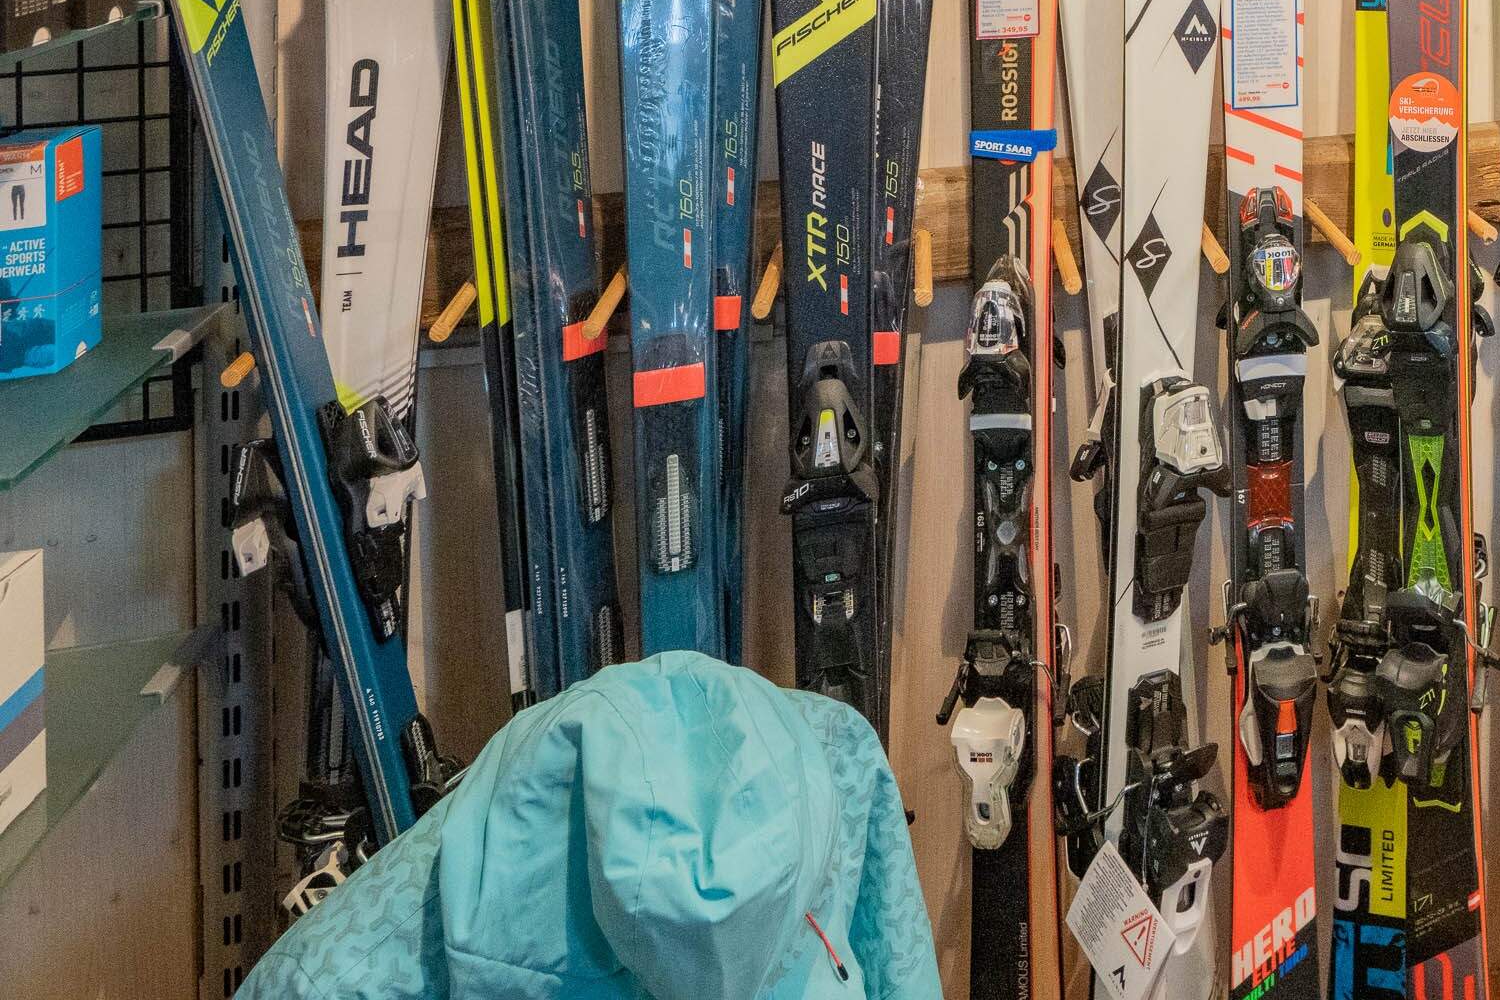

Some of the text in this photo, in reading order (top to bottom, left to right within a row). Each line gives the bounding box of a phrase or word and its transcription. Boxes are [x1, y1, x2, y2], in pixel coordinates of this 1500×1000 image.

[1001, 42, 1019, 121] ROSSIG
[1399, 97, 1415, 106] SKI-
[1399, 105, 1454, 117] VERSICHERUNG
[1401, 126, 1438, 135] JETZT HIER
[336, 58, 379, 258] HEAD
[725, 119, 739, 159] 165
[974, 140, 1033, 155] SPORT SAAR
[1401, 134, 1450, 144] ABSCHLIESSEN
[31, 164, 42, 175] M
[573, 151, 583, 192] 165
[885, 158, 899, 199] 155
[1397, 148, 1450, 183] TRIPLE RADIUS
[680, 179, 694, 220] 160
[806, 141, 828, 292] XTR RACE
[5, 250, 45, 266] SPORTS
[10, 238, 45, 252] ACTIVE
[836, 223, 850, 266] 150
[286, 247, 304, 289] 160
[341, 289, 353, 313] TEAM
[1260, 382, 1287, 391] KONECT
[356, 409, 377, 459] FISCHER
[233, 447, 248, 506] FISCHER
[1238, 489, 1246, 505] 167
[976, 511, 985, 528] 163
[1381, 829, 1395, 902] LIMITED
[1123, 907, 1149, 926] WARNING
[1147, 917, 1159, 970] AVERTISSEMENT
[1232, 886, 1316, 990] HERO
[1017, 921, 1029, 1000] AMOUS Limited
[1252, 936, 1297, 988] ELITE
